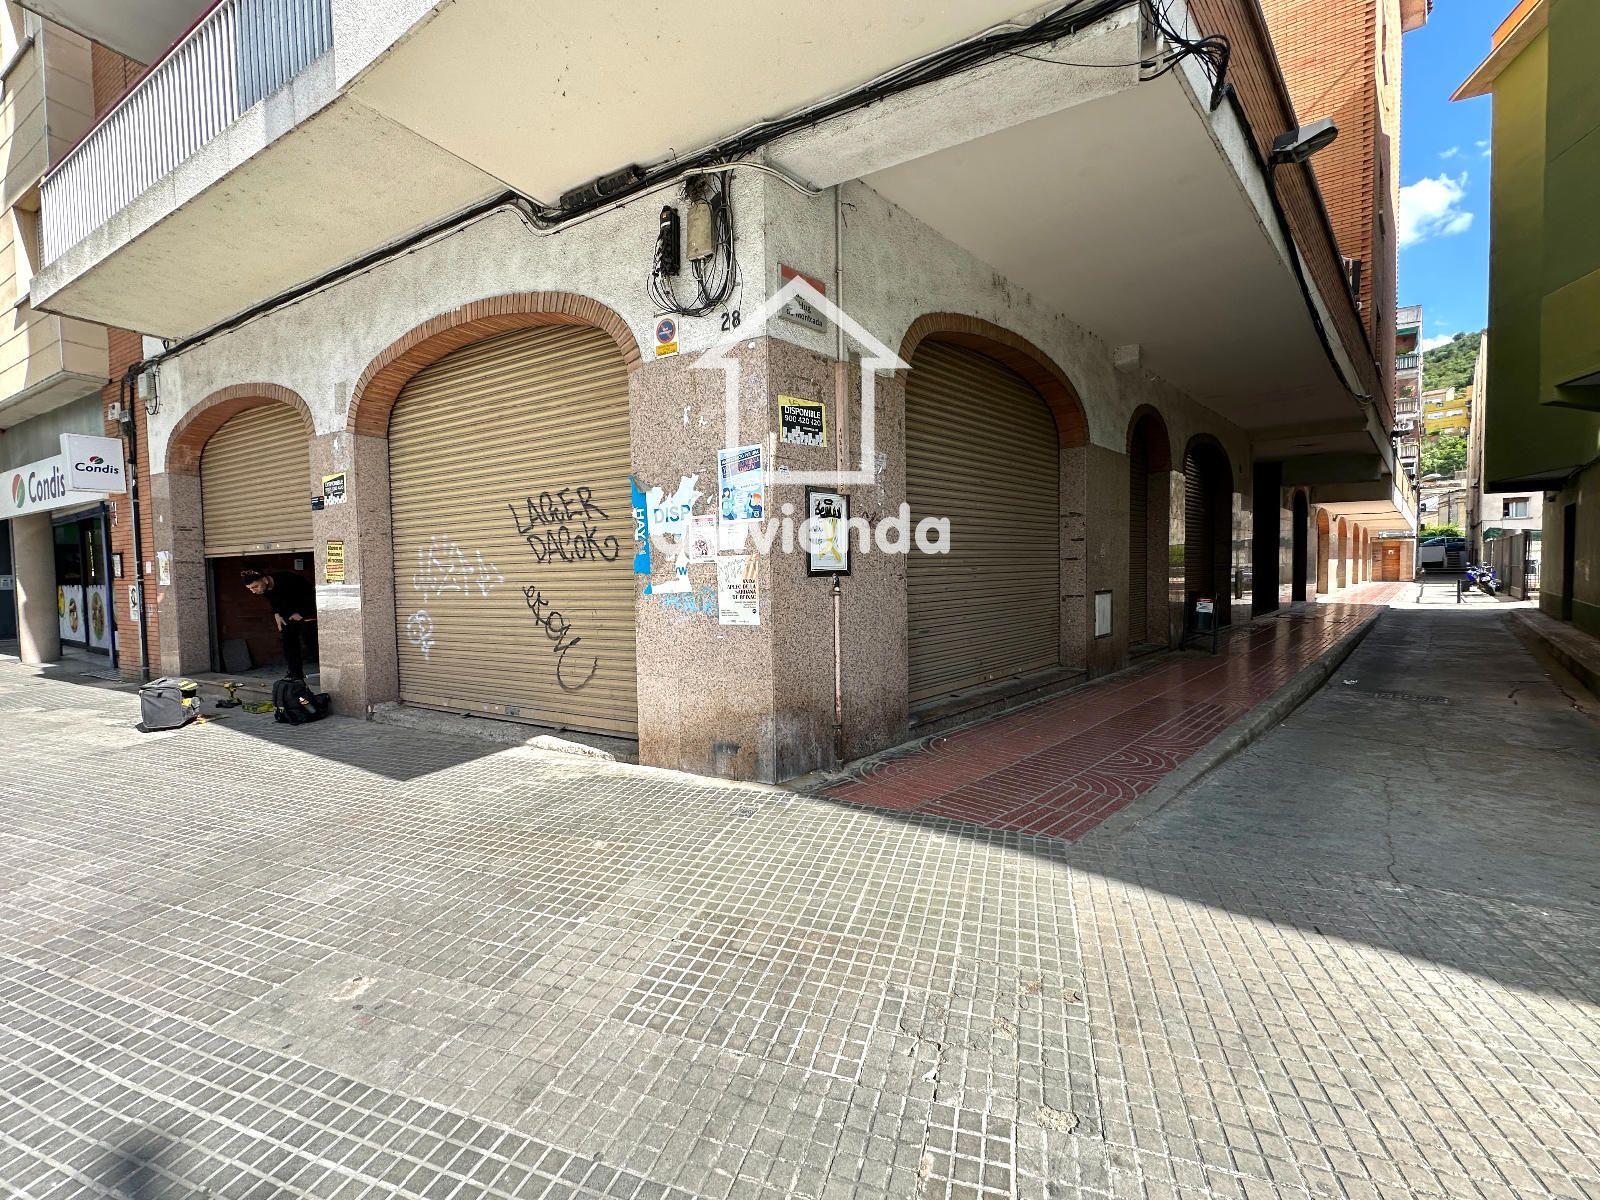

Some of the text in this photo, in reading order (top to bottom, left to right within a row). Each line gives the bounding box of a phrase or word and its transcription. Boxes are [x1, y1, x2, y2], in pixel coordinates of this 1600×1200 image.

[720, 309, 741, 331] 28
[784, 414, 797, 423] 900
[75, 462, 119, 475] Condis
[28, 465, 66, 503] Condis
